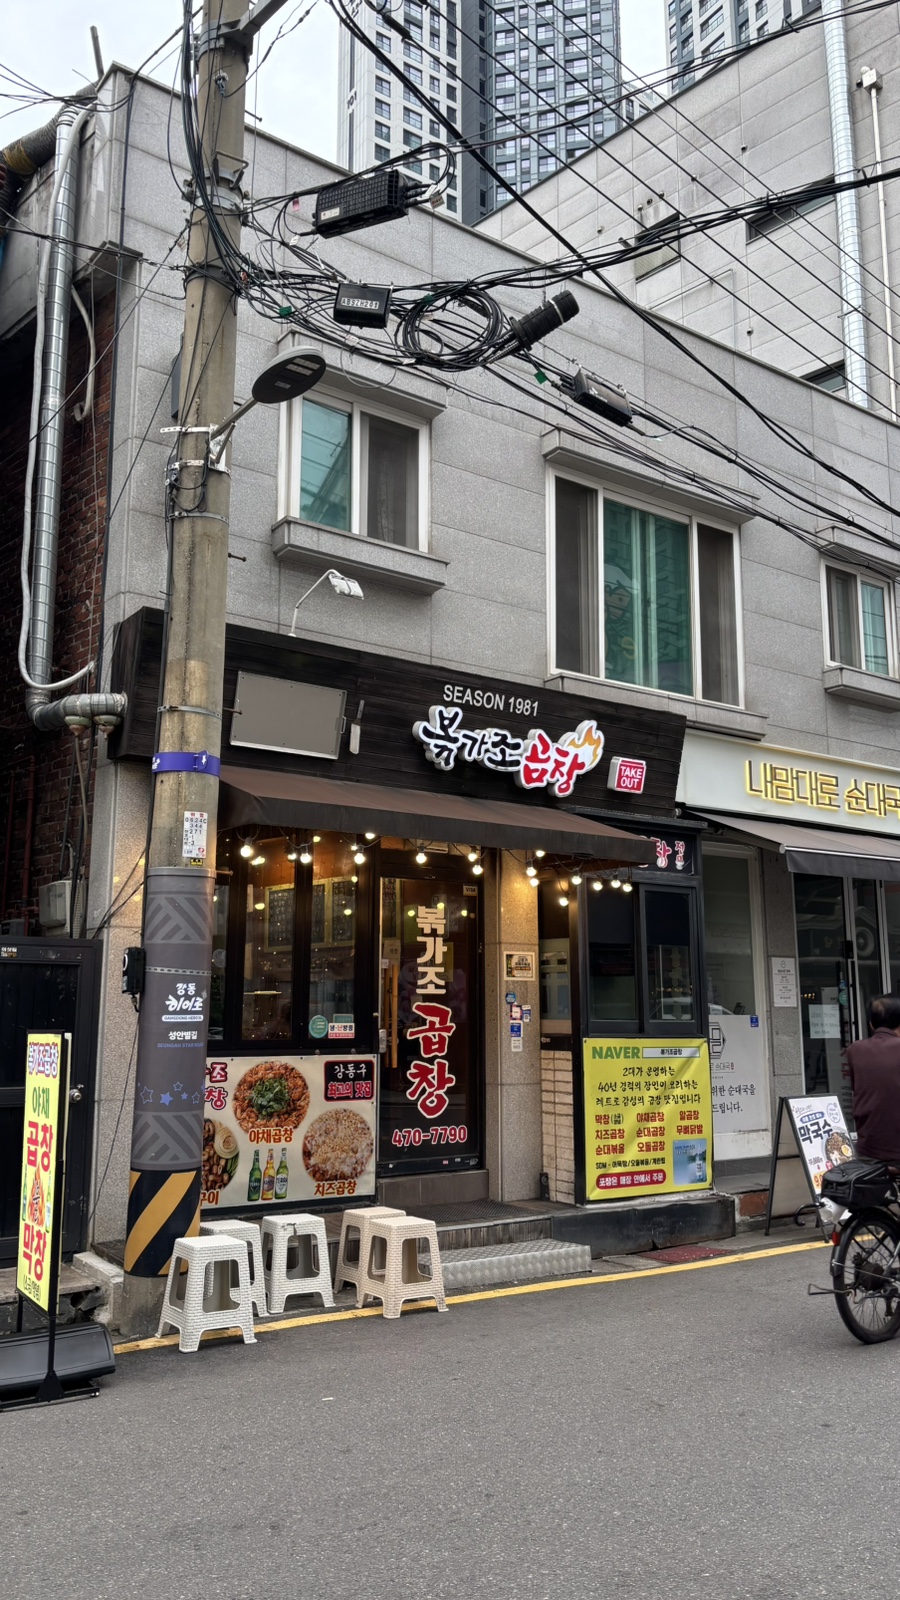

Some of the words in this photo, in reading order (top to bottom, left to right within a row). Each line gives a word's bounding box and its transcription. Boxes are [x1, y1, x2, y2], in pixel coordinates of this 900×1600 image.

[443, 684, 505, 711] SEASON
[508, 698, 539, 717] 1981
[620, 766, 642, 779] TAKE
[620, 777, 640, 788] OUT
[745, 759, 841, 811] 내맘대로
[176, 983, 197, 996] 강동
[165, 994, 204, 1011] 히어로
[592, 1046, 640, 1060] NAVER
[206, 1061, 228, 1083] 조
[334, 1063, 367, 1079] 강동구
[622, 1066, 643, 1077] 2대가
[645, 1066, 676, 1077] 운영하는
[327, 1081, 353, 1098] 최고의
[355, 1081, 372, 1097] 맛집
[597, 1081, 618, 1092] 40년
[620, 1081, 642, 1092] 경력의
[644, 1080, 667, 1092] 장인이
[668, 1079, 699, 1090] 요리하는
[727, 1084, 756, 1097] 순대국을
[32, 1086, 50, 1119] 야채
[596, 1097, 620, 1107] 레트로
[622, 1096, 645, 1107] 감성의
[647, 1095, 662, 1106] 곱창
[712, 1101, 743, 1114] 드립니다.
[595, 1114, 610, 1125] 막창
[636, 1112, 665, 1123] 야채곱창
[679, 1110, 699, 1121] 알곱창
[249, 1127, 294, 1144] 야채곱창
[392, 1125, 468, 1147] 470-7790
[595, 1128, 625, 1140] 치즈곱창
[636, 1126, 665, 1138] 순대곱창
[798, 1119, 833, 1144] 막국수
[27, 1120, 53, 1172] 곱창
[595, 1143, 625, 1156] 순대볶음
[314, 1180, 357, 1197] 치즈곱창
[23, 1222, 47, 1282] 막창
